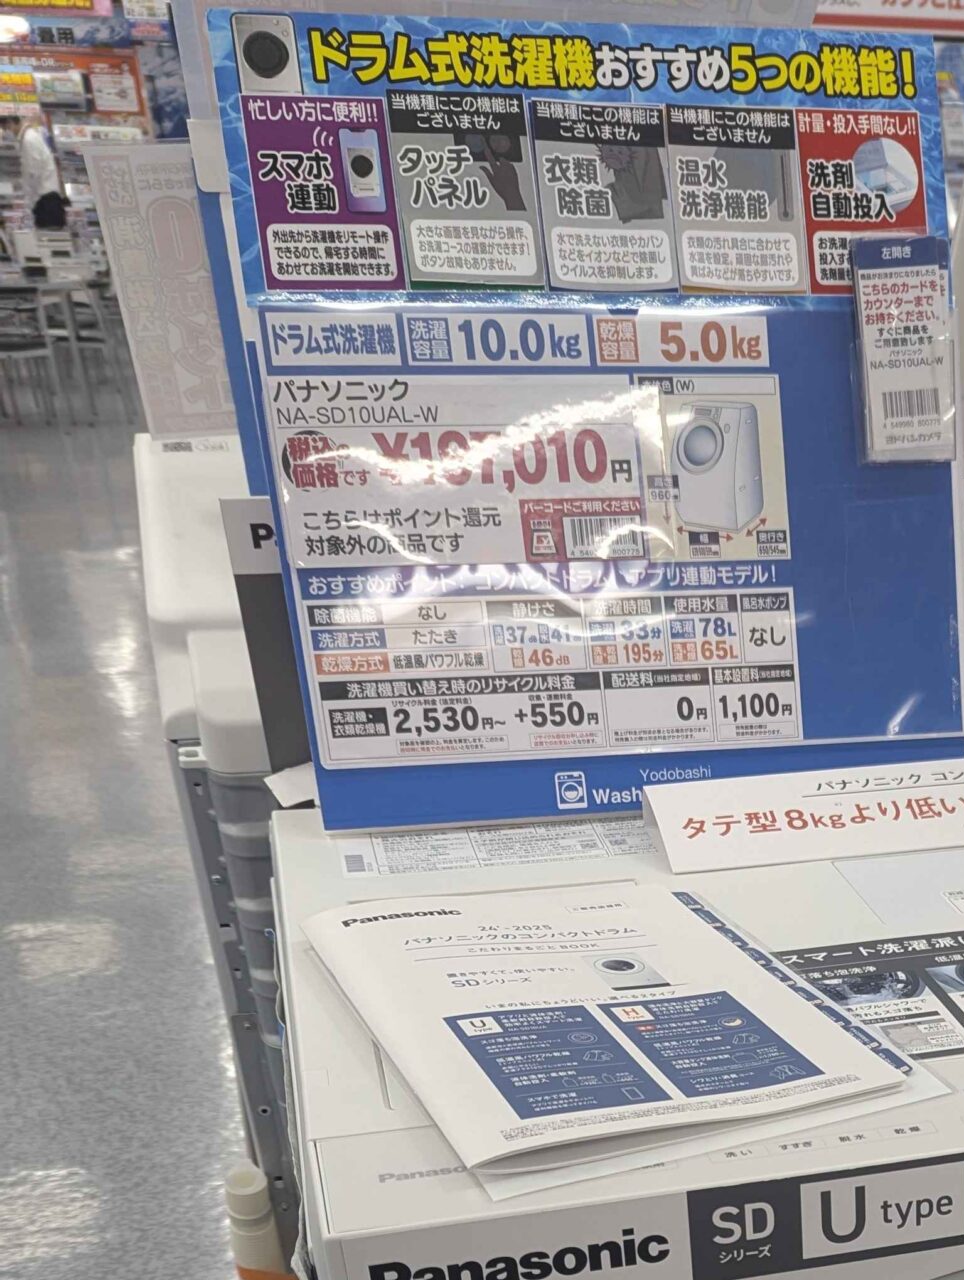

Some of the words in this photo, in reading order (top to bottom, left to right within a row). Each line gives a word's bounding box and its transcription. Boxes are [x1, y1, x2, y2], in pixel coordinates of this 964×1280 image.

[307, 28, 917, 98] ドラム式洗濯機おすすめ5つの機能!
[248, 99, 378, 123] 忙しい方に便利!!
[391, 93, 520, 114] 当機種にこの機能は
[536, 102, 660, 125] 当機種にこの機能は
[416, 112, 501, 131] ございません
[670, 107, 791, 129] 当機種にこの機能は
[798, 113, 917, 136] 計量・投入手間なし!!
[559, 120, 641, 142] ございません
[692, 125, 772, 144] ございません
[258, 151, 334, 182] スマホ
[398, 147, 471, 176] タッチ
[542, 154, 601, 187] 衣類
[676, 157, 728, 190] 温水
[808, 160, 855, 190] 洗剤
[286, 183, 338, 214] 連動
[410, 178, 487, 208] パネル
[557, 189, 611, 219] 除菌
[678, 190, 769, 222] 洗浄機能
[811, 193, 896, 222] 自動投入
[881, 245, 912, 260] 左開き
[559, 264, 661, 280] ウイルスを抑制します。
[862, 279, 939, 297] こちらのカードを
[863, 295, 934, 312] カウンターまで
[865, 311, 940, 327] お持ちください。
[271, 323, 397, 356] ドラム式洗濯機
[409, 320, 447, 340] 洗濯
[457, 317, 580, 363] 10.0kg
[600, 320, 635, 341] 乾燥
[877, 325, 929, 338] すぐに商品を
[413, 340, 450, 360] 容量
[601, 341, 638, 362] 容量
[660, 320, 761, 362] 5.0kg
[870, 356, 944, 371] NA-SD10UAL-W
[889, 348, 923, 358] パナソニック
[273, 379, 409, 402] パナソニック
[675, 380, 695, 394] (W)
[277, 406, 438, 426] NA-SD10UAL-W
[293, 462, 371, 489] 価格です
[303, 507, 502, 531] こちらはポイント還元
[523, 502, 641, 515] バーコードご利用ください
[305, 533, 465, 557] 対象外の商品です
[758, 531, 787, 544] 奥行き
[417, 604, 447, 621] なし
[673, 598, 730, 614] 使用水量
[699, 617, 737, 638] 78L
[749, 626, 786, 647] なし
[317, 630, 381, 648] 洗濯方式
[412, 629, 458, 645] たたき
[528, 648, 571, 669] 46dB
[623, 643, 664, 663] 195分
[701, 640, 738, 661] 65L
[320, 653, 384, 673] 乾燥方式
[392, 652, 485, 671] 低温風パワフル乾燥
[346, 675, 576, 699] 洗濯機買い替え時のリサイクル料金
[676, 696, 708, 721] 0円
[718, 692, 793, 723] 1,100円
[333, 721, 387, 737] 衣類乾燥機
[639, 764, 712, 783] Yodobashi
[816, 772, 925, 793] パナソニック
[592, 786, 643, 805] Wash
[341, 908, 463, 929] Panasonic
[403, 926, 638, 946] パナソニックのコンパクトドラム
[450, 975, 533, 989] SDシリーズ
[621, 1007, 640, 1017] H
[469, 1019, 487, 1029] U
[837, 1132, 867, 1143] 脱水
[892, 1124, 922, 1136] 乾燥
[724, 1148, 754, 1160] 洗い
[778, 1139, 814, 1152] すすぎ
[711, 1201, 776, 1246] SD
[818, 1184, 868, 1245] U
[880, 1191, 954, 1229] type
[719, 1244, 772, 1265] シリーズ
